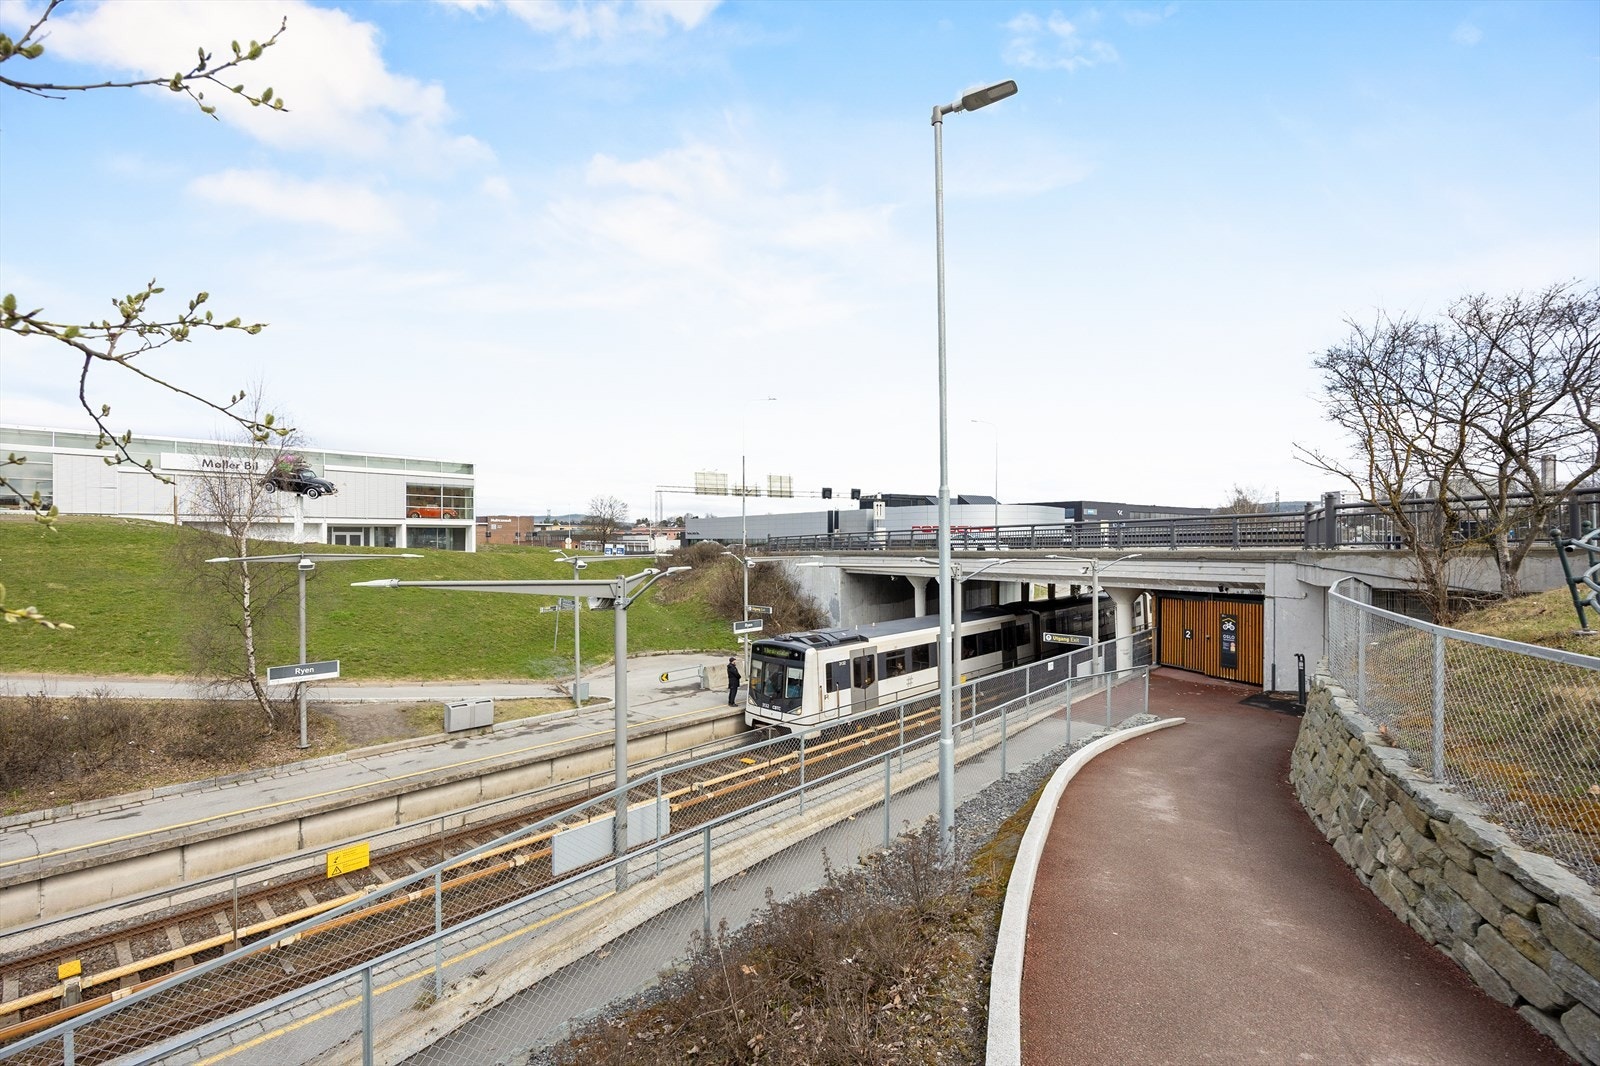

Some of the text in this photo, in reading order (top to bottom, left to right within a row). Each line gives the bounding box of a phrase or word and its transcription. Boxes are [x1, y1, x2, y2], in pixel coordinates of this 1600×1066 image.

[202, 459, 258, 470] Møller Bil
[1185, 630, 1191, 638] 2
[1052, 635, 1070, 643] Utgang
[294, 667, 315, 675] Ryen
